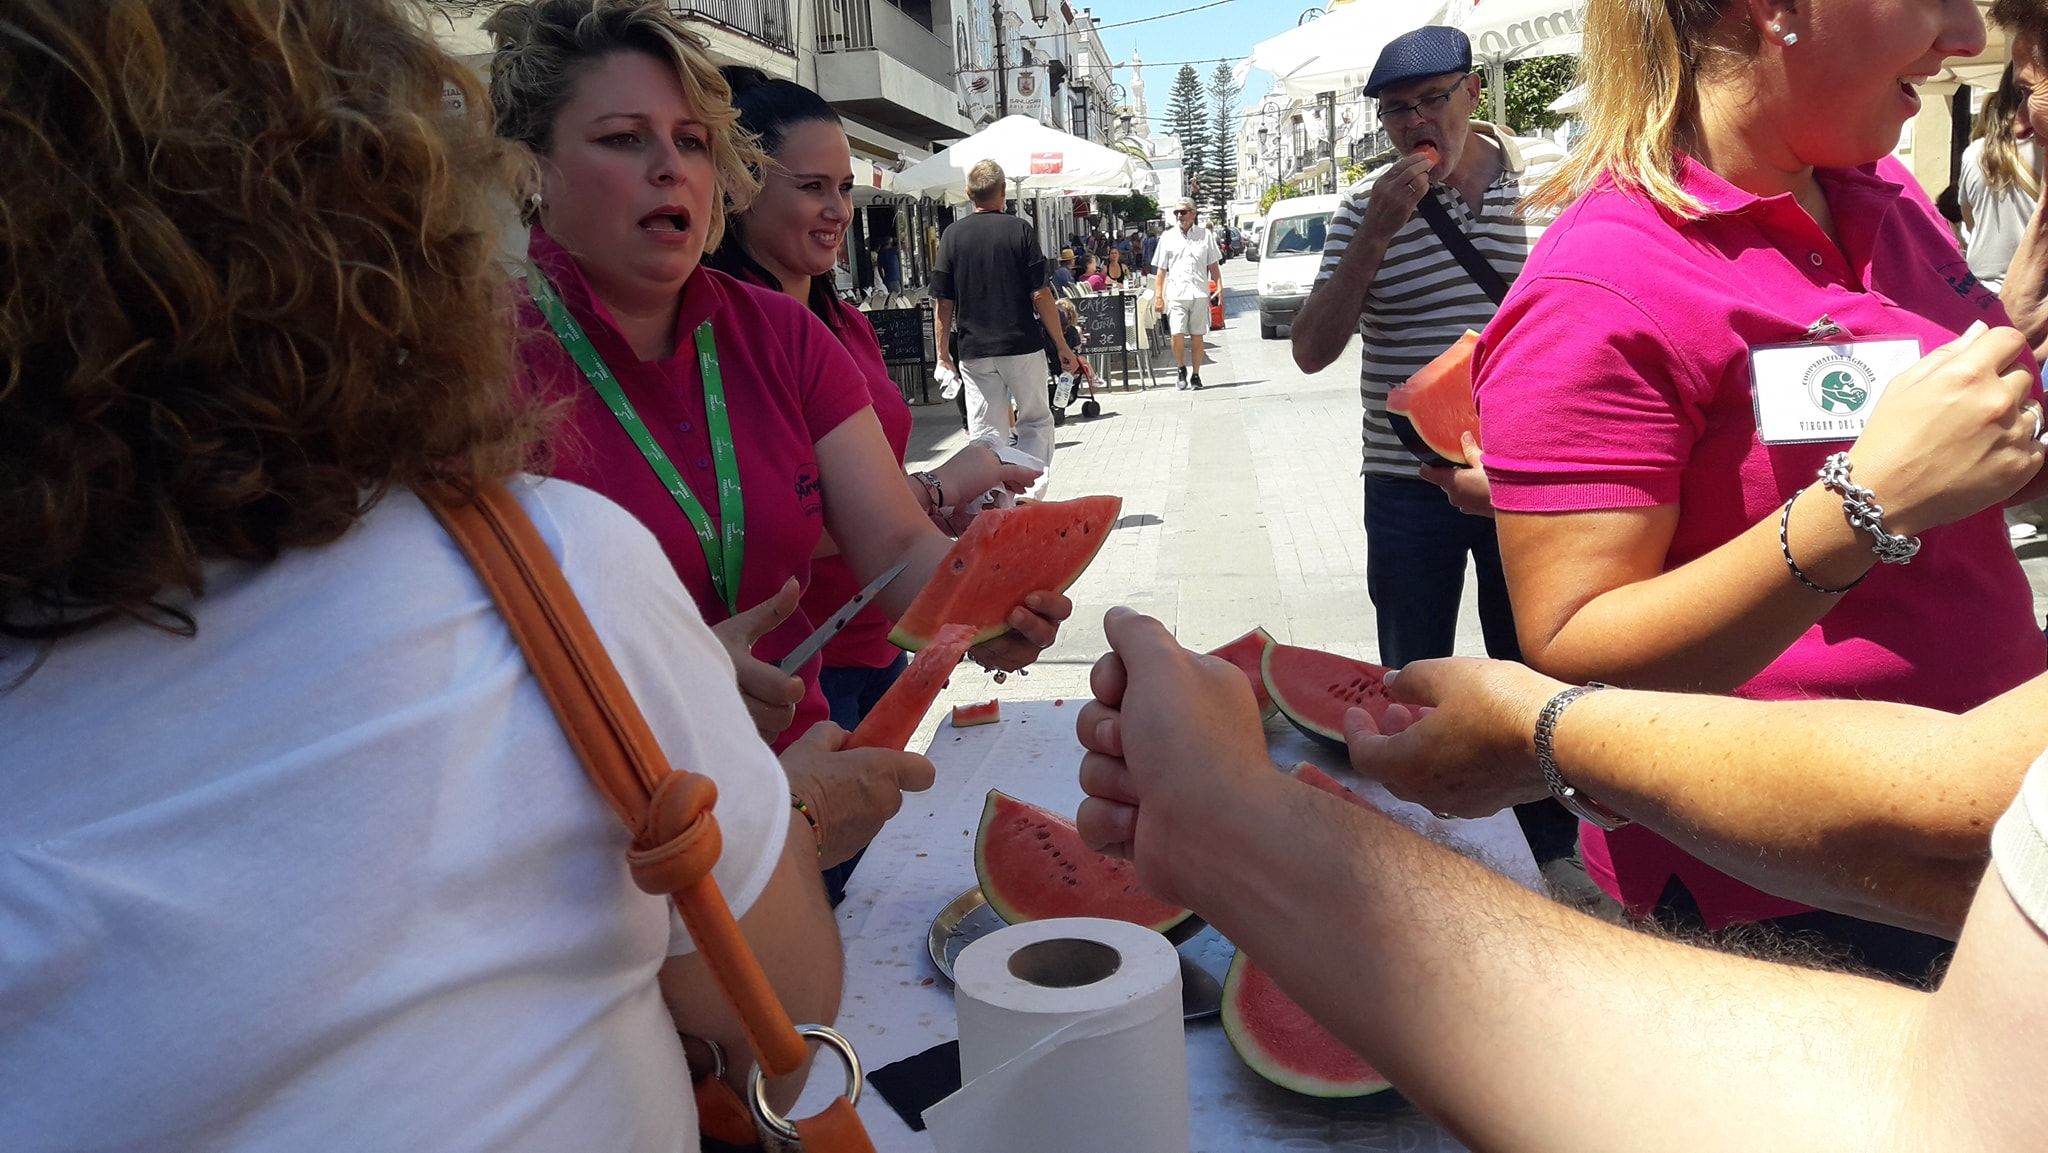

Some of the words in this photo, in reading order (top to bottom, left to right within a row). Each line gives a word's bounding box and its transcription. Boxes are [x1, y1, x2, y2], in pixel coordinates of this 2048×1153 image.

[1802, 355, 1844, 386] COOPERATIVA
[1846, 355, 1877, 383] AGRARIA
[1799, 421, 1833, 431] VIRGEN
[1838, 419, 1855, 430] DEL
